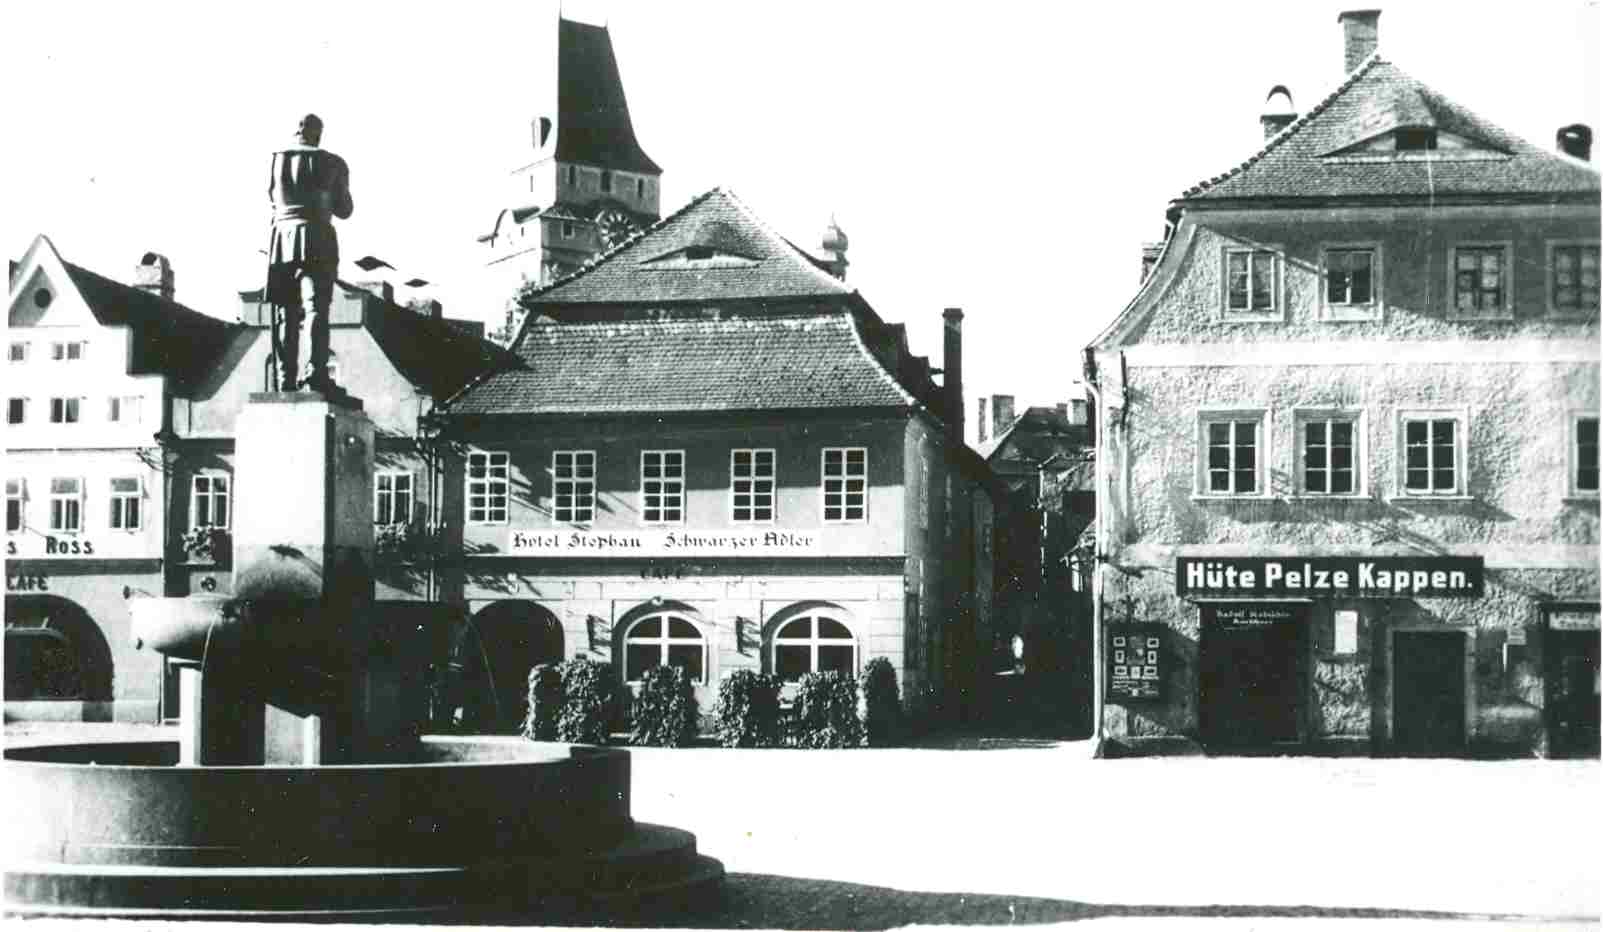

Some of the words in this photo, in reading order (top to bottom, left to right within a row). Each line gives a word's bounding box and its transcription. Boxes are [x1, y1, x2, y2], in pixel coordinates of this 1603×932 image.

[45, 535, 94, 554] Ross
[513, 532, 559, 548] Hotel
[568, 532, 641, 549] Stephan
[664, 532, 758, 549] Schwarzer
[763, 531, 814, 547] Adler
[1186, 562, 1256, 589] Hüte
[1265, 562, 1349, 589] Pelze
[1358, 562, 1473, 592] Kappen.
